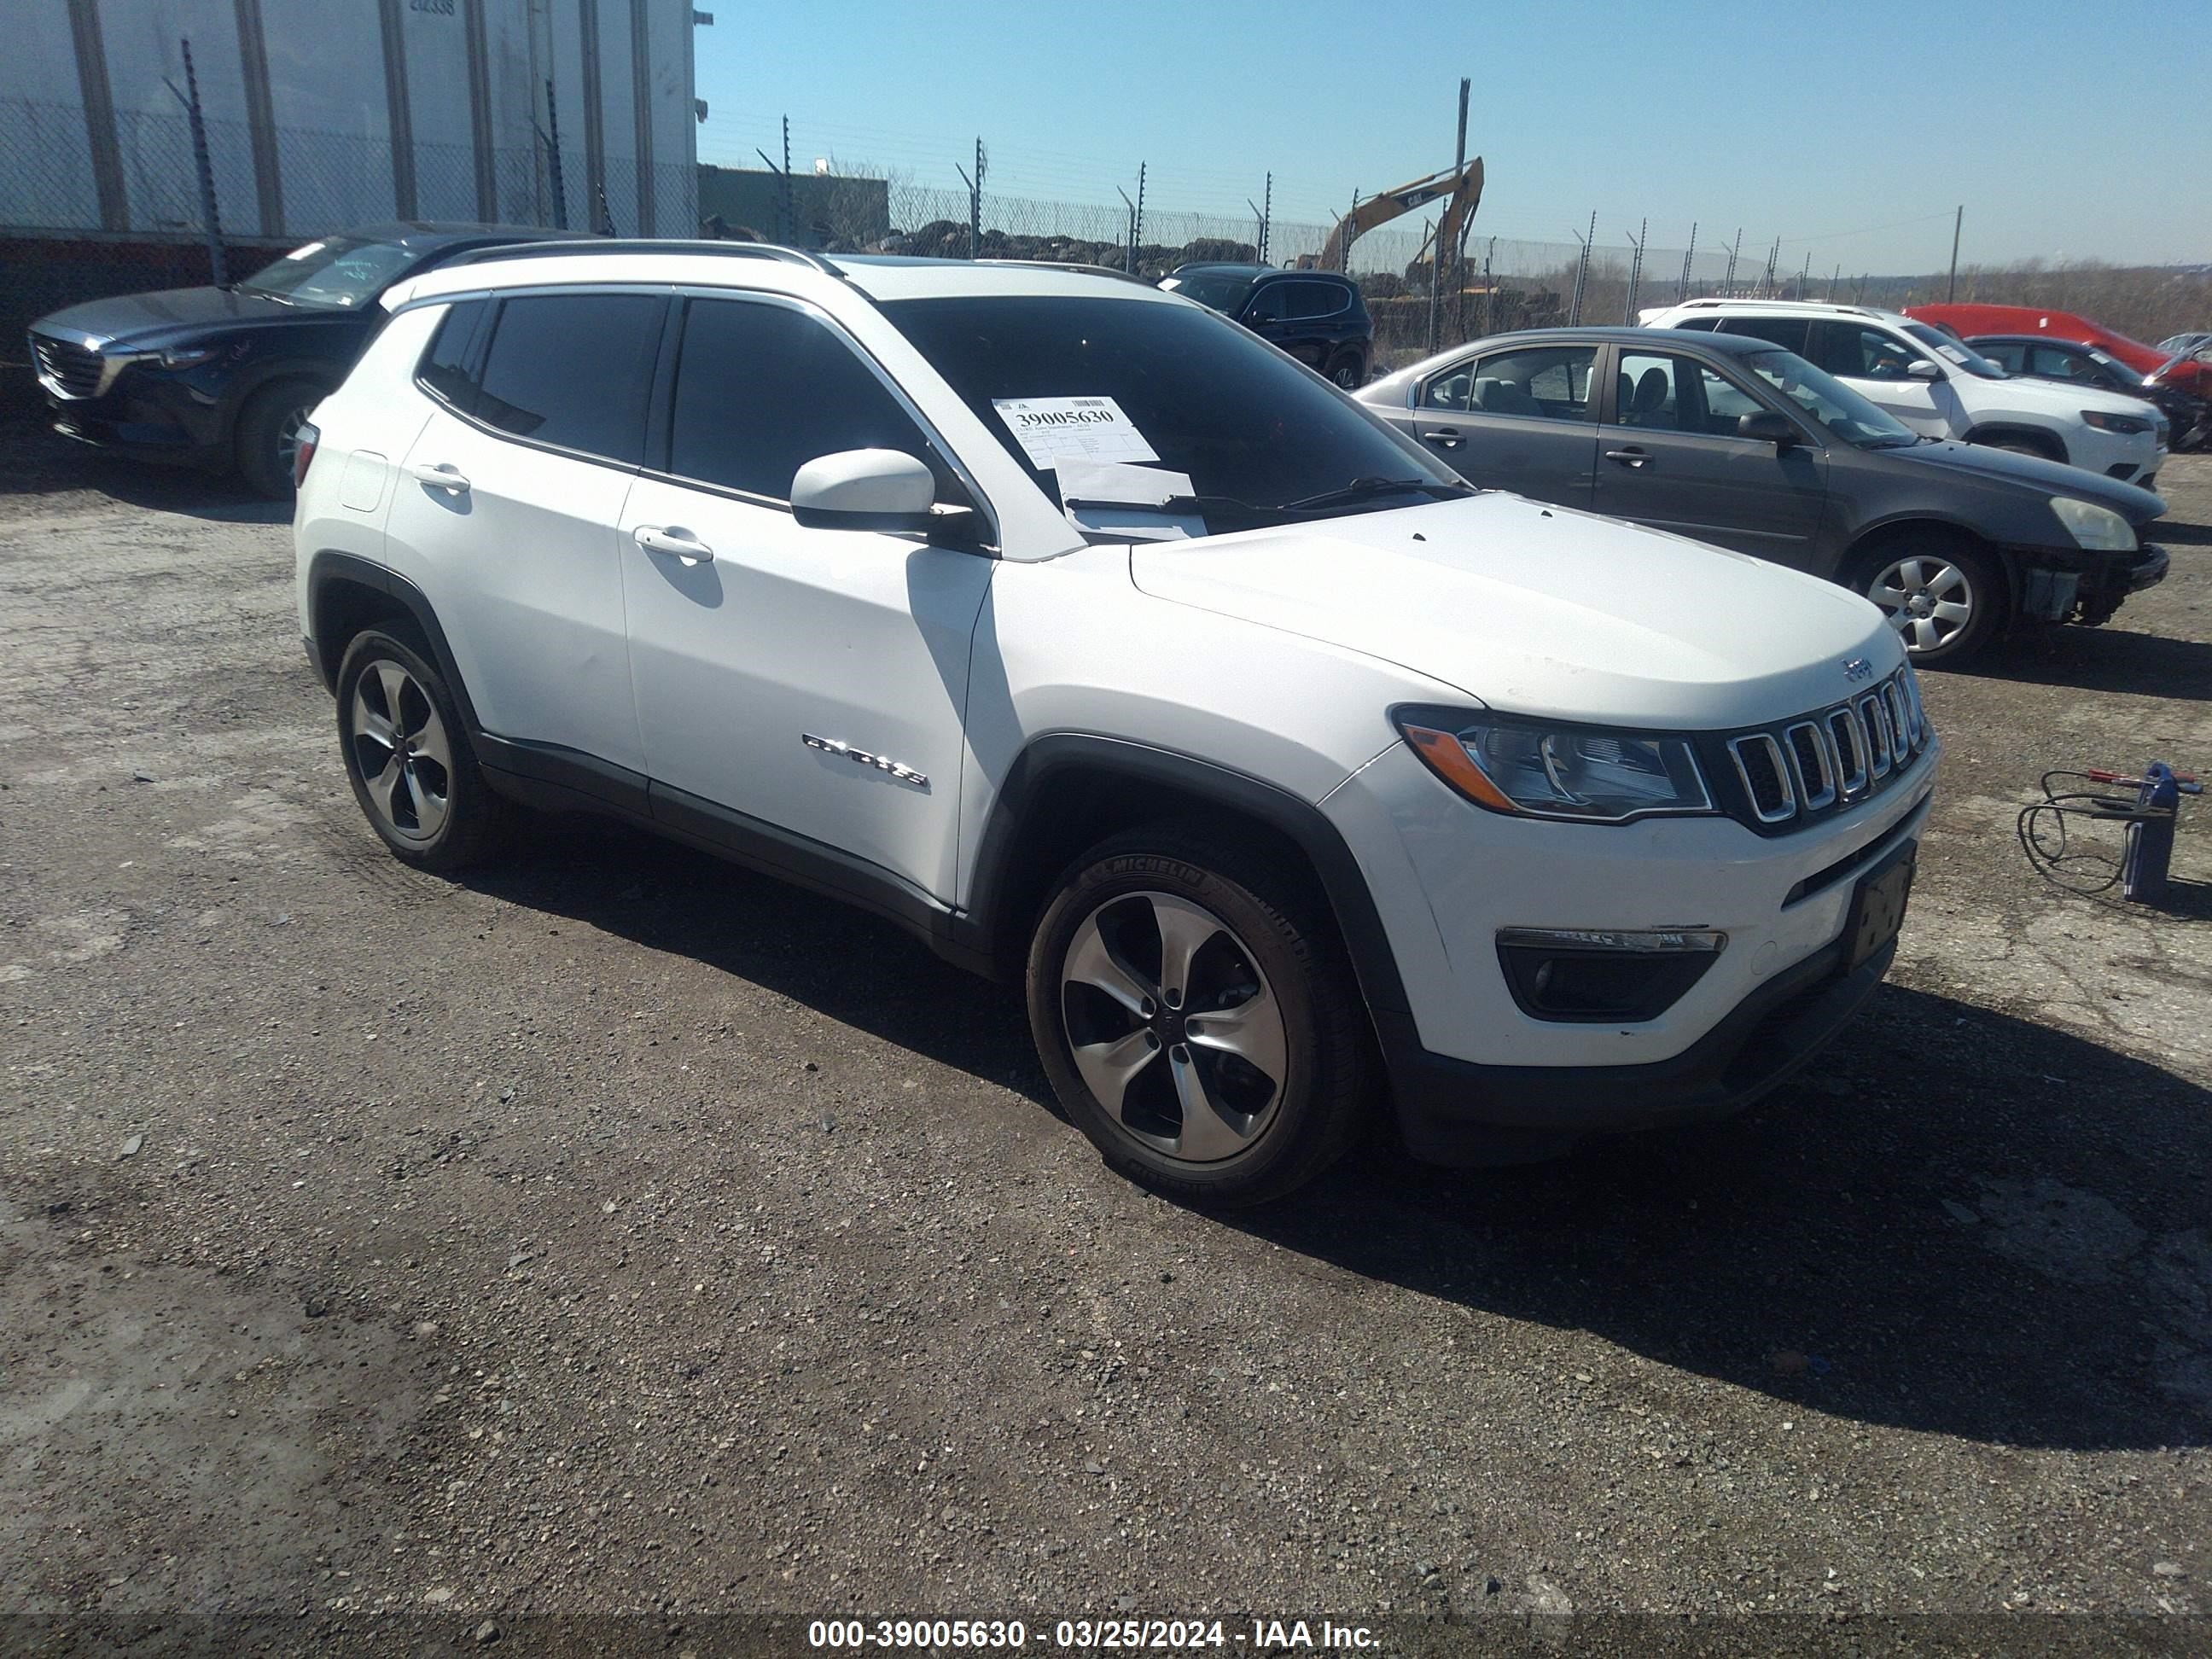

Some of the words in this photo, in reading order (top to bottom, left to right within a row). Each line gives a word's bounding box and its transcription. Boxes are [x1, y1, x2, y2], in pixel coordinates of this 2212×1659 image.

[1408, 193, 1423, 207] CAT
[1016, 410, 1114, 427] 39005630
[1112, 858, 1202, 885] MICHELIN
